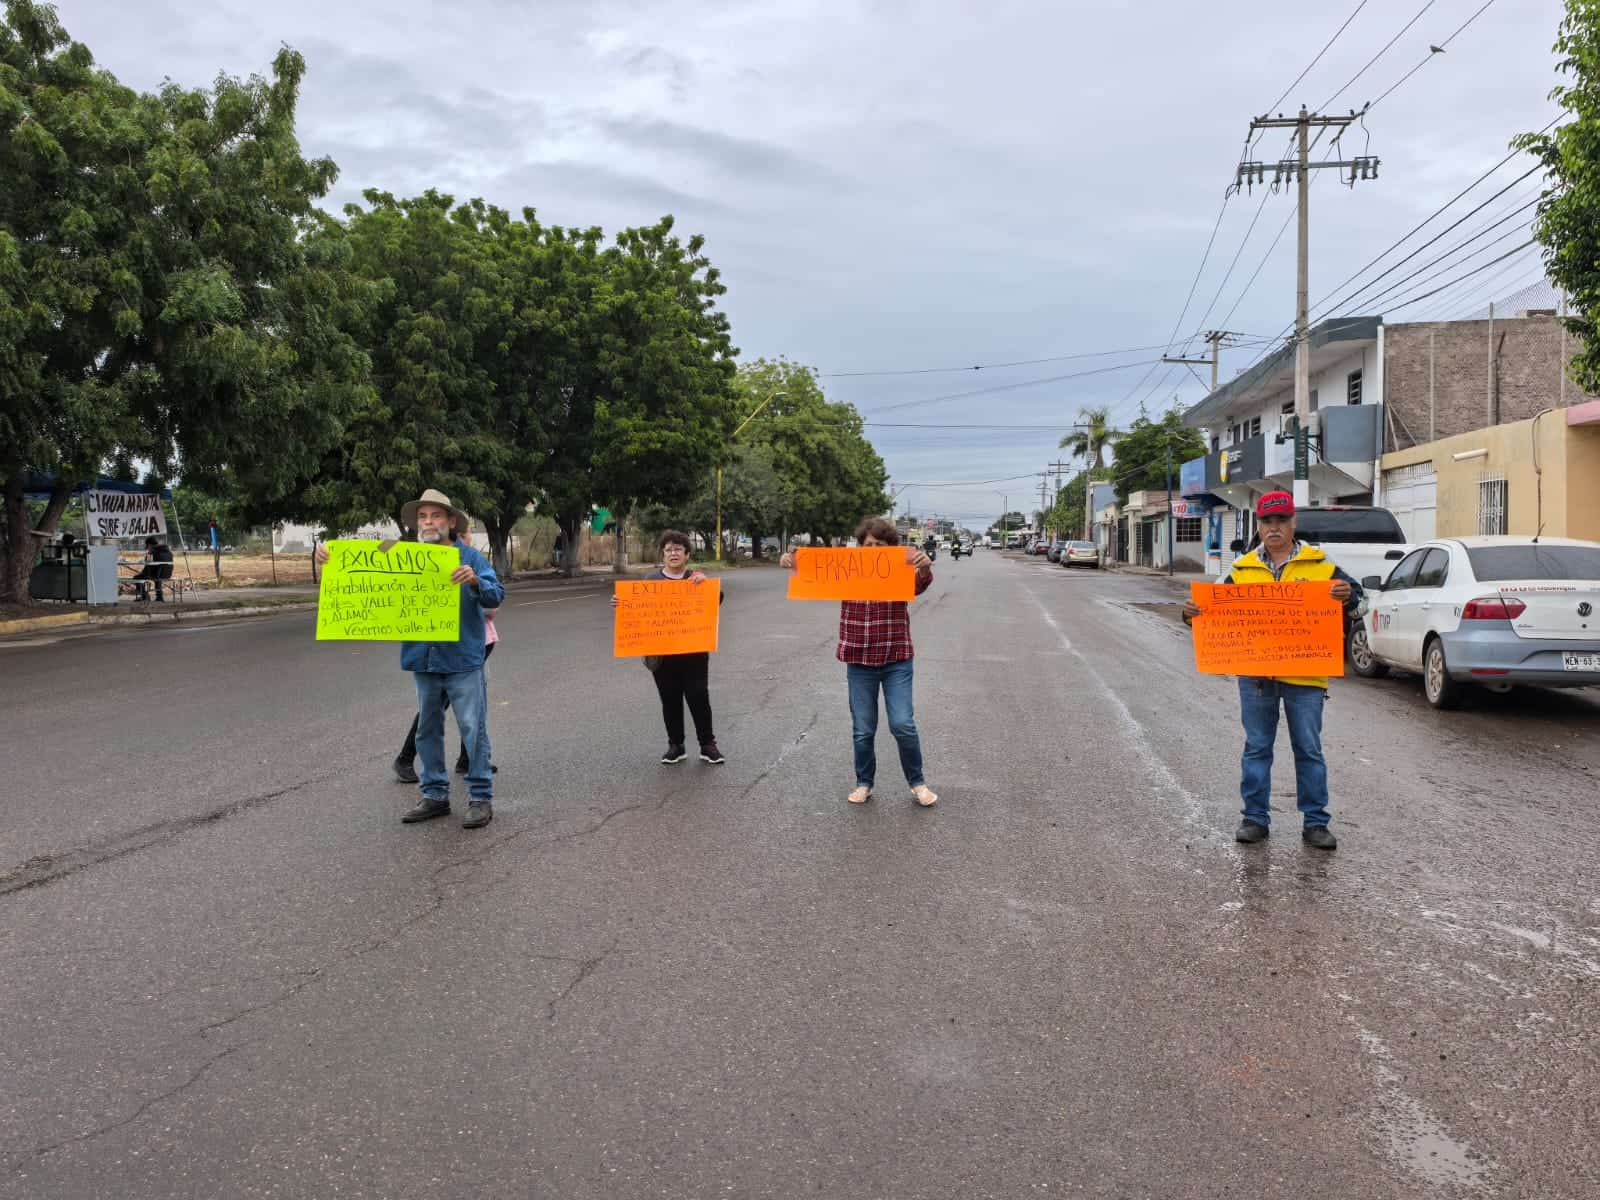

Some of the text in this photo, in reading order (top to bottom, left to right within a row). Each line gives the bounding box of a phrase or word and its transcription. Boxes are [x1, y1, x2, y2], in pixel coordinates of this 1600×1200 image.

[128, 515, 160, 535] BAJA
[411, 577, 427, 592] de
[360, 595, 394, 609] VALLE
